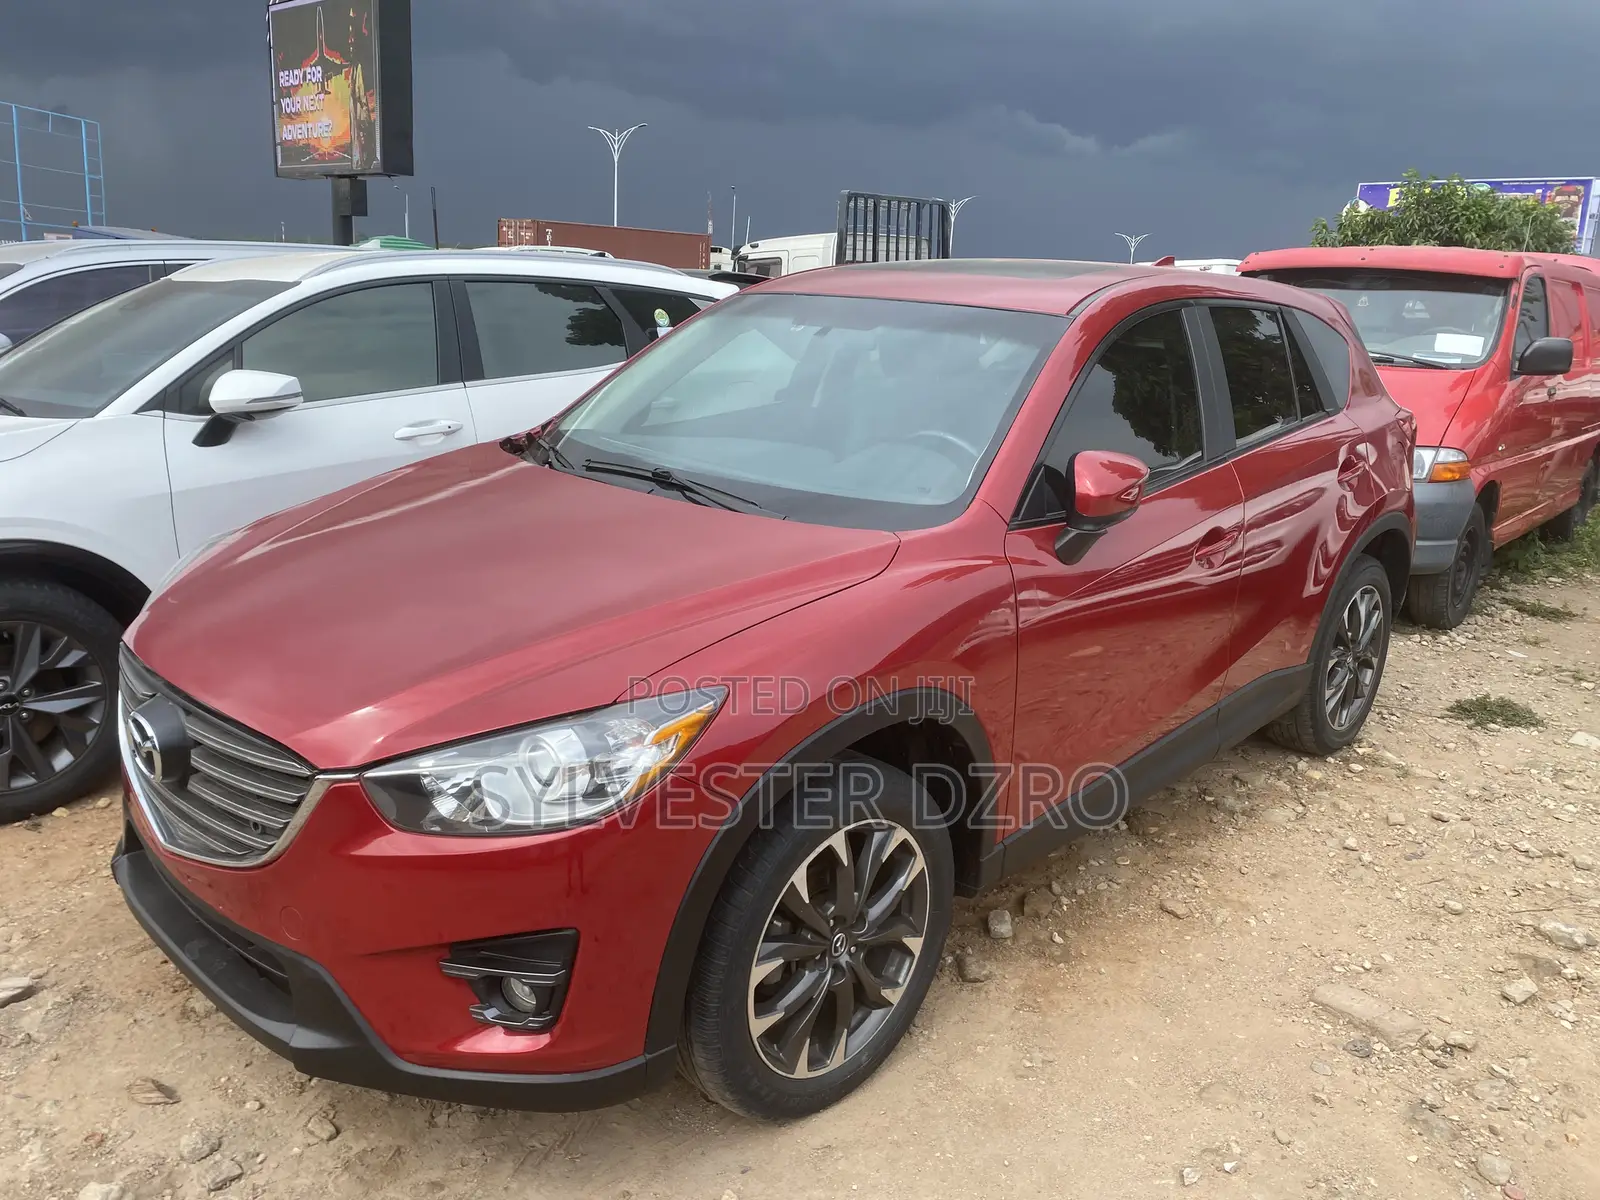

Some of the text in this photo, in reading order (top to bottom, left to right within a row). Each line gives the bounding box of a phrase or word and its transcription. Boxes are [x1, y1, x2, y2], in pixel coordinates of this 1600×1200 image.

[279, 66, 322, 87] READY FOR
[280, 94, 324, 114] YOUR NEXT
[282, 120, 332, 140] ADVENTURE?
